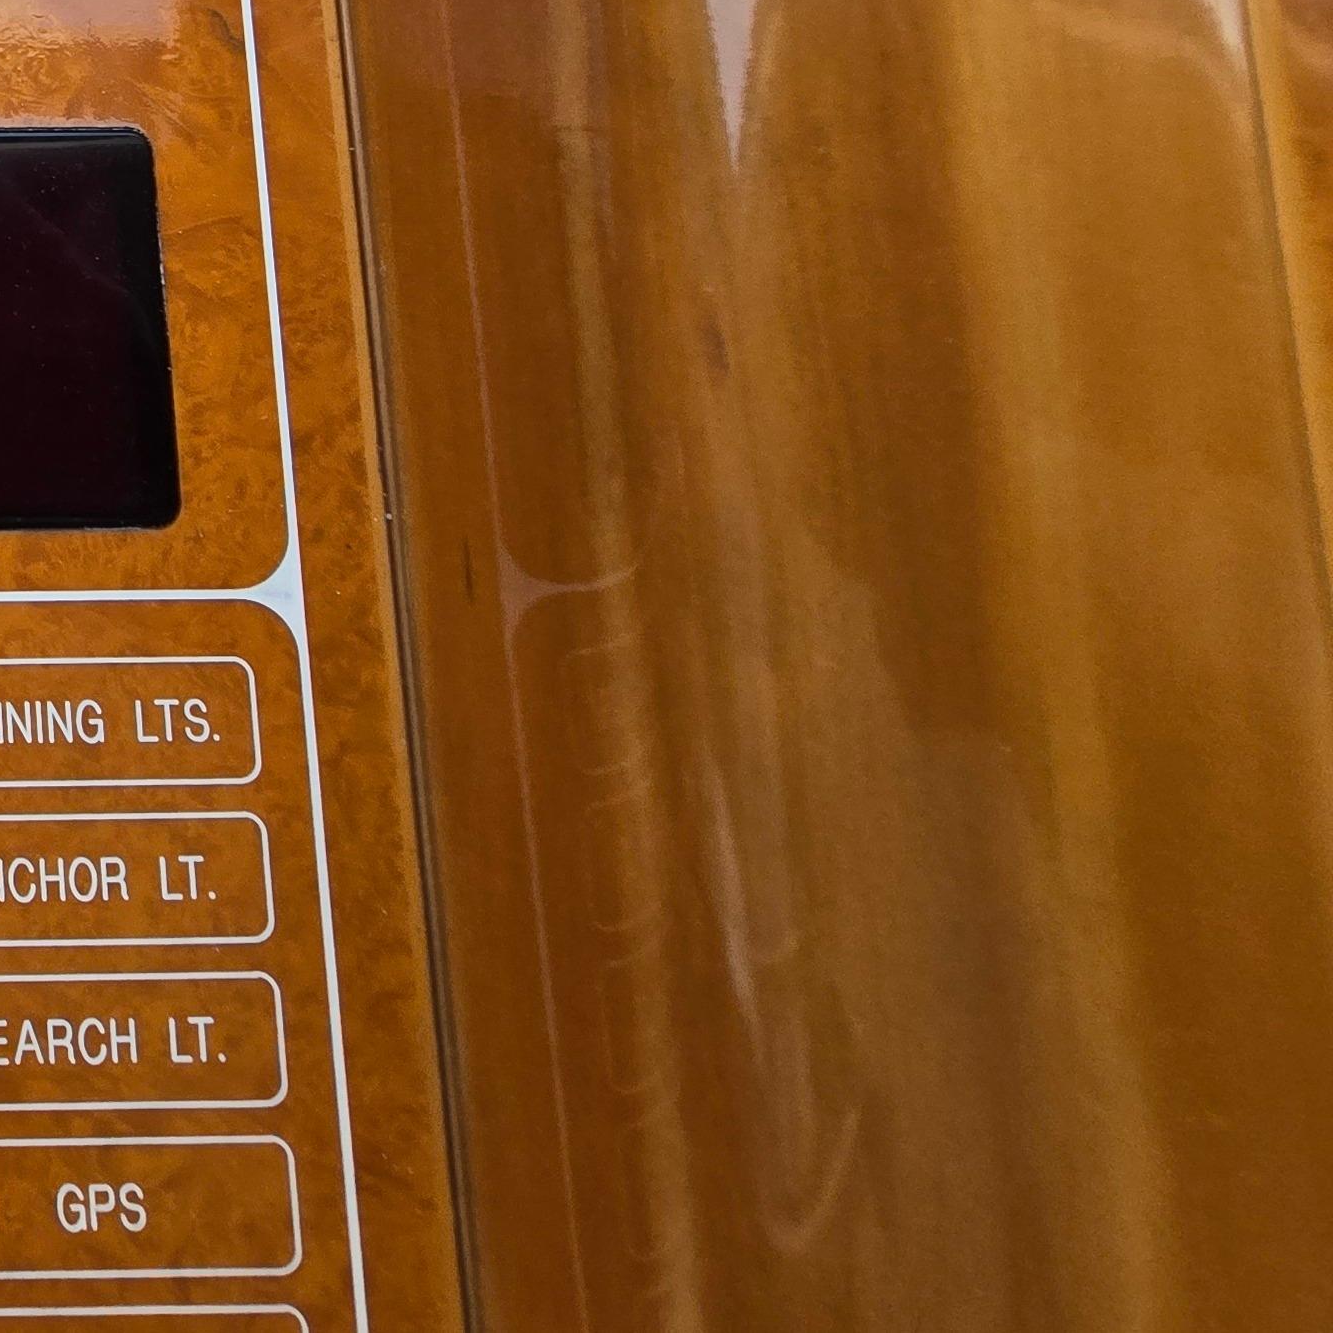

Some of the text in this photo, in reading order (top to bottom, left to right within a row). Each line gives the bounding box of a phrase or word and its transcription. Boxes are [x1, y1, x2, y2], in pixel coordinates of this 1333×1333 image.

[135, 697, 221, 744] LTS.
[158, 854, 218, 902] LT.
[167, 1015, 228, 1064] LT.
[55, 1181, 148, 1234] GPS
